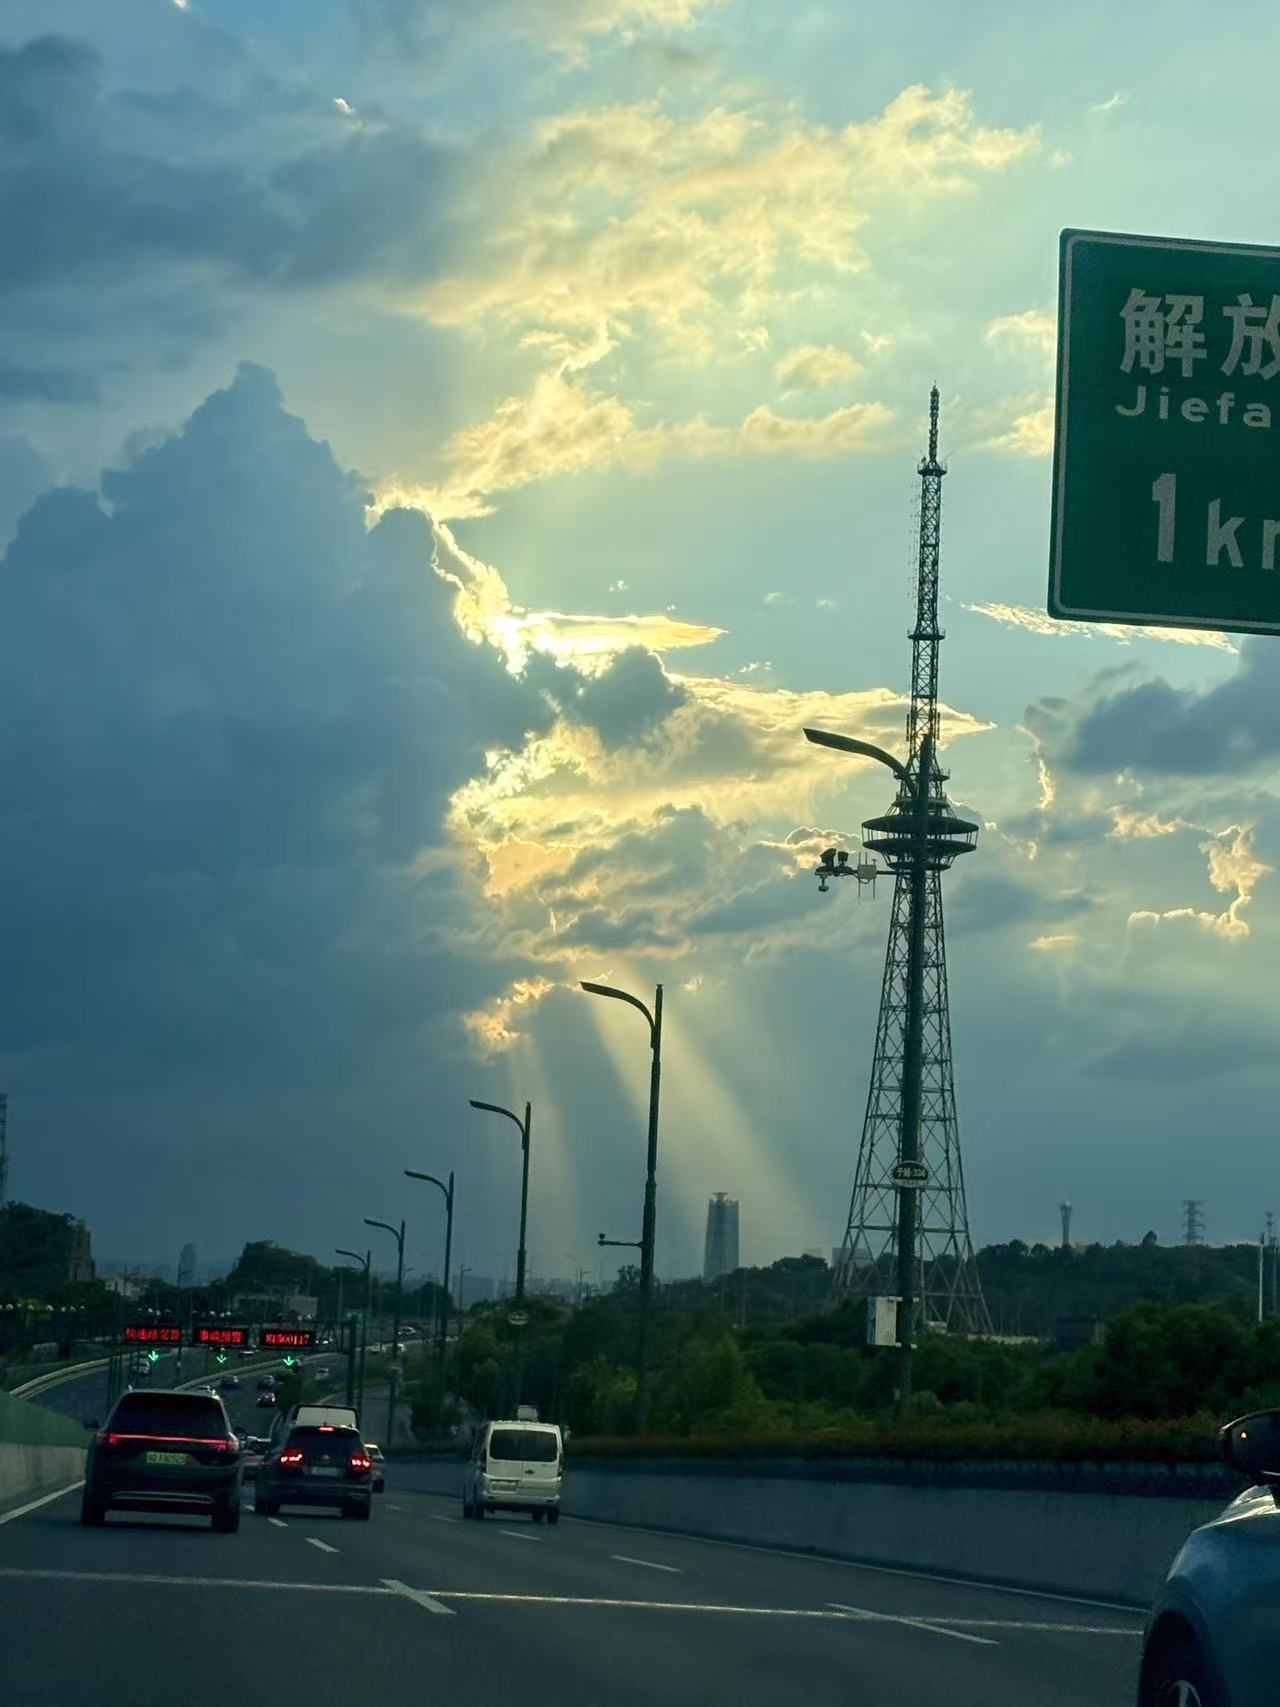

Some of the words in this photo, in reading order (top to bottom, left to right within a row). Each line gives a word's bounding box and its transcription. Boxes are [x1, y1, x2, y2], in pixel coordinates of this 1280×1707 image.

[1119, 287, 1280, 378] 解放
[1116, 385, 1272, 428] Jiefa
[1152, 472, 1177, 563] 1
